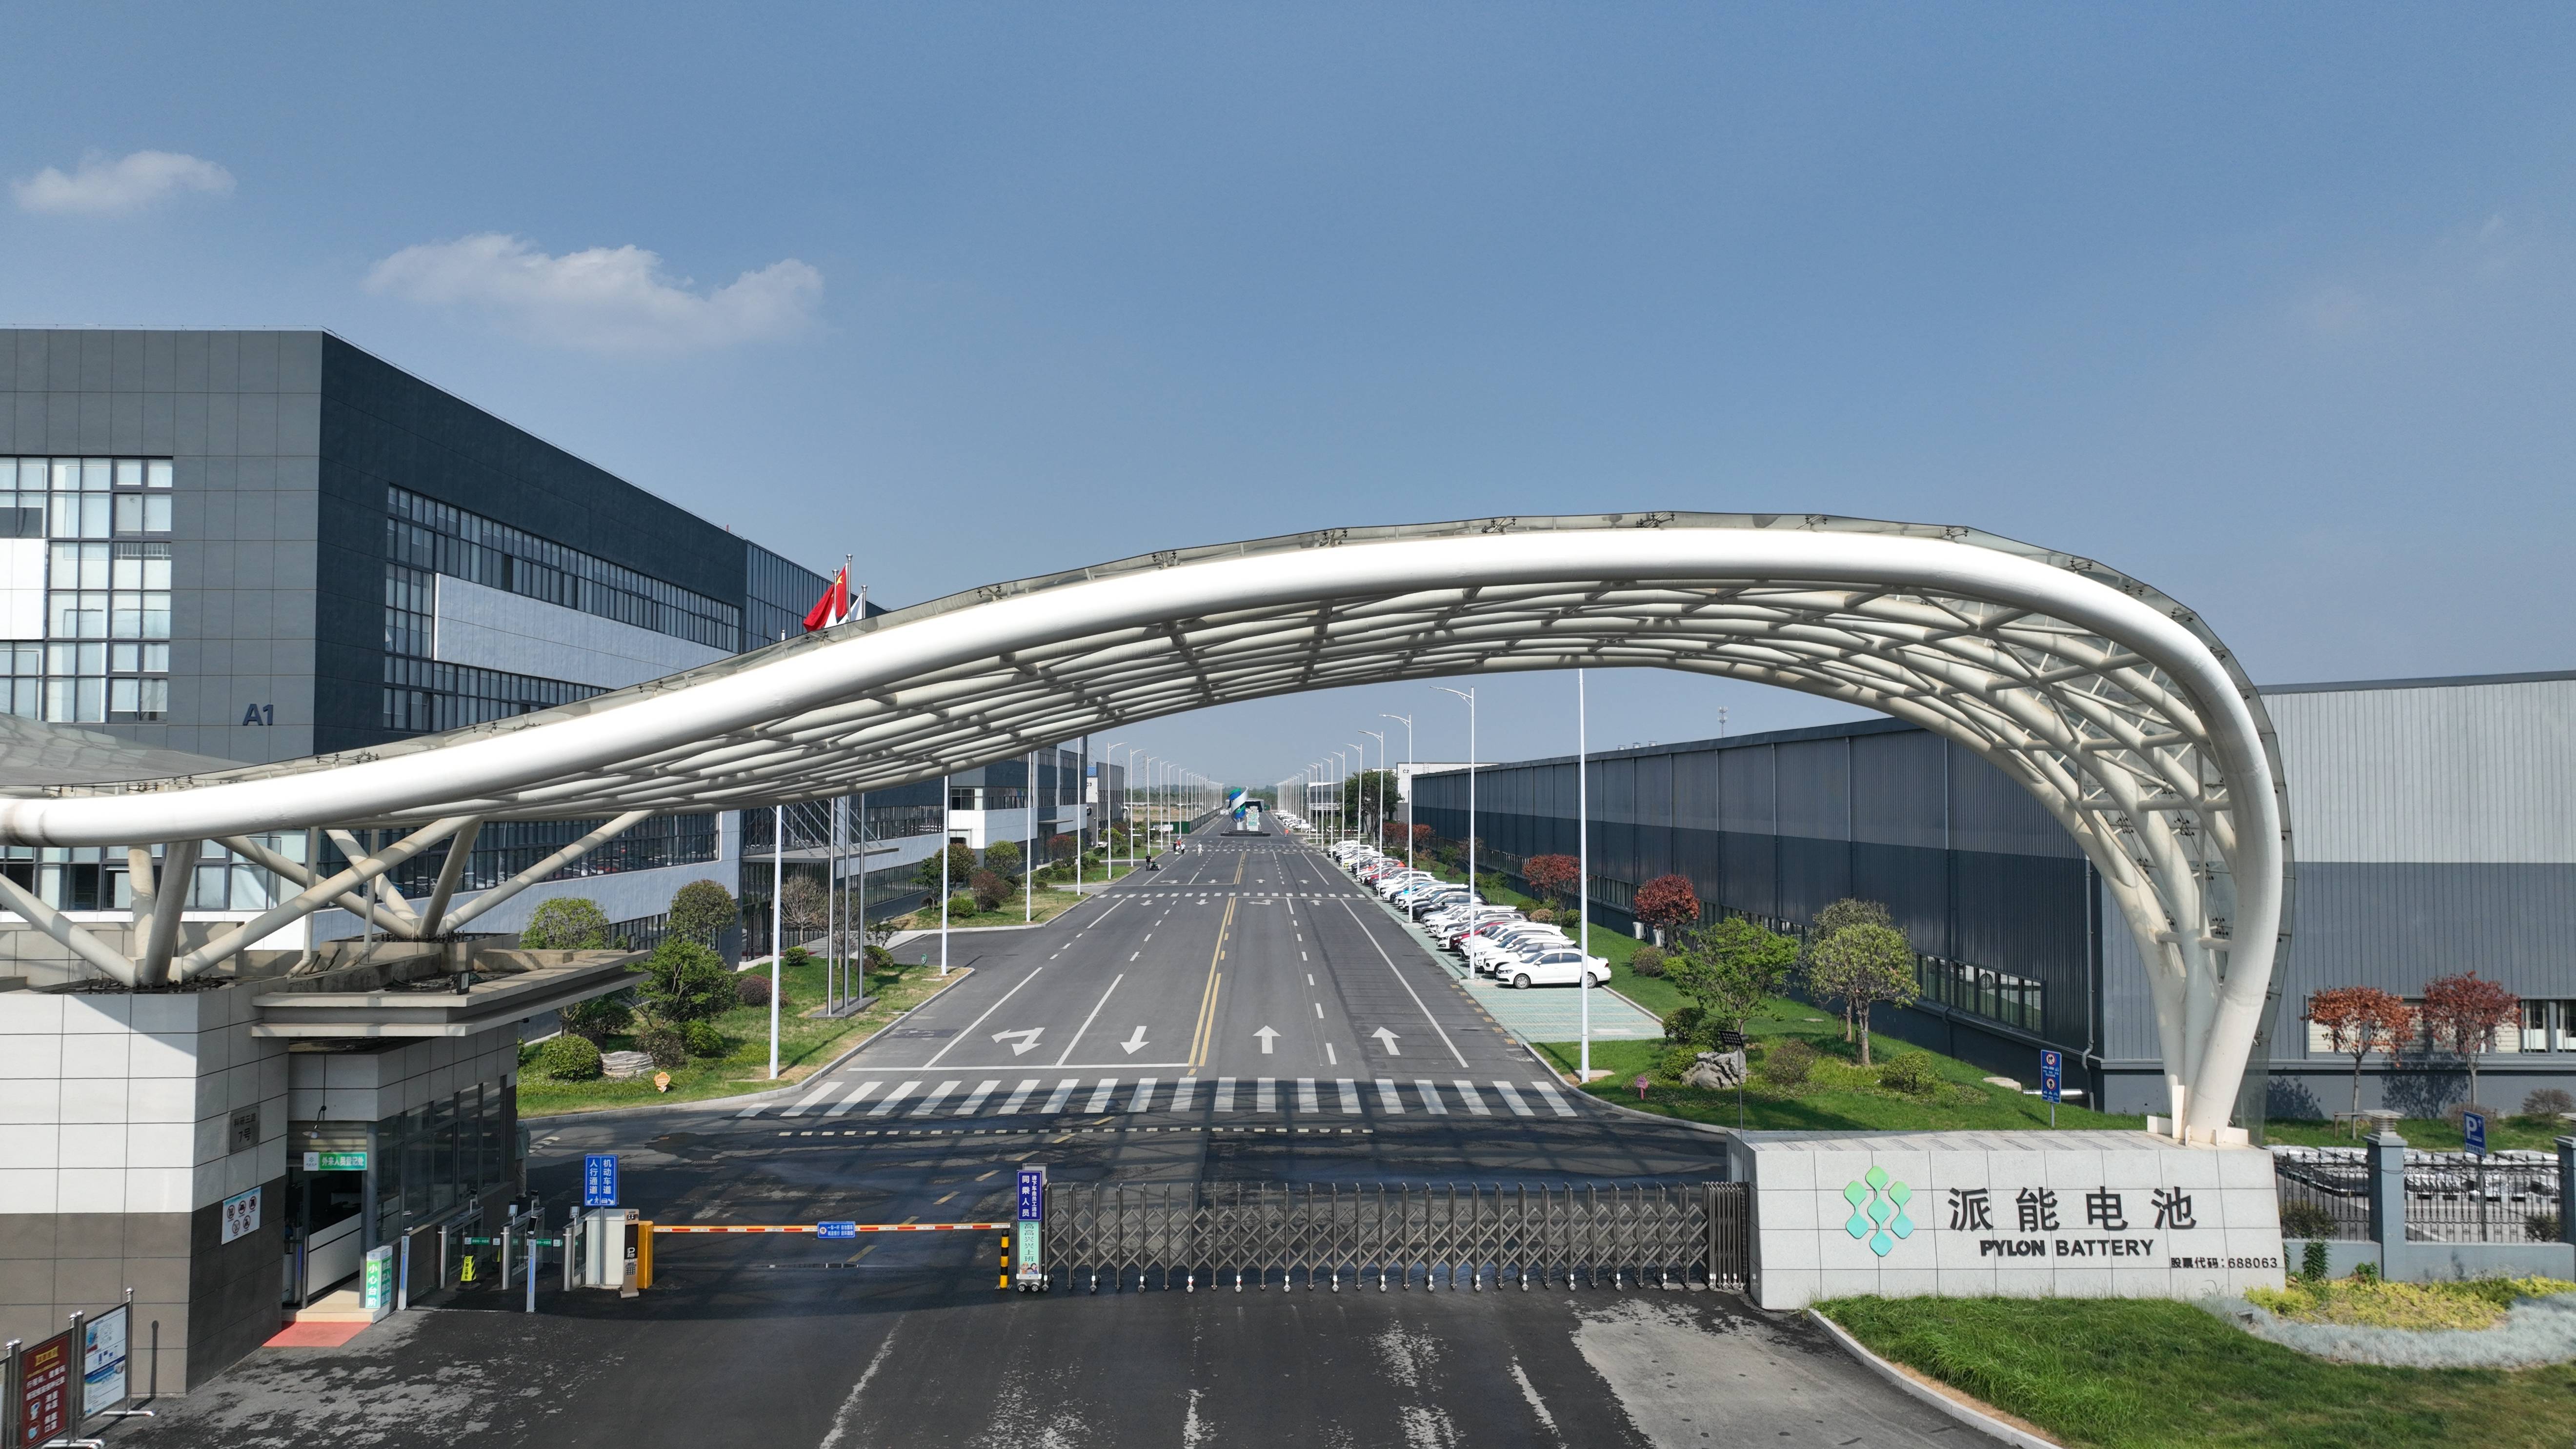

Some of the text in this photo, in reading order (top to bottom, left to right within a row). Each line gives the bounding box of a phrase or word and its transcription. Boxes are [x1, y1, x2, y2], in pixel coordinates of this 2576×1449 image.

[242, 704, 274, 726] A1
[234, 1113, 256, 1127] 科研三路
[2465, 1115, 2477, 1139] P
[322, 1156, 364, 1166] 外来人员登记处
[589, 1159, 598, 1194] 人行通道
[603, 1159, 612, 1194] 机动车道
[1022, 1175, 1030, 1217] 同乘人员
[1948, 1186, 2196, 1232] 派能电池
[1024, 1223, 1035, 1262] 高高兴兴上班
[1979, 1240, 2154, 1256] PYLON BATTERY
[2171, 1257, 2277, 1268] 股票代码：688063
[367, 1264, 378, 1307] 小心台阶
